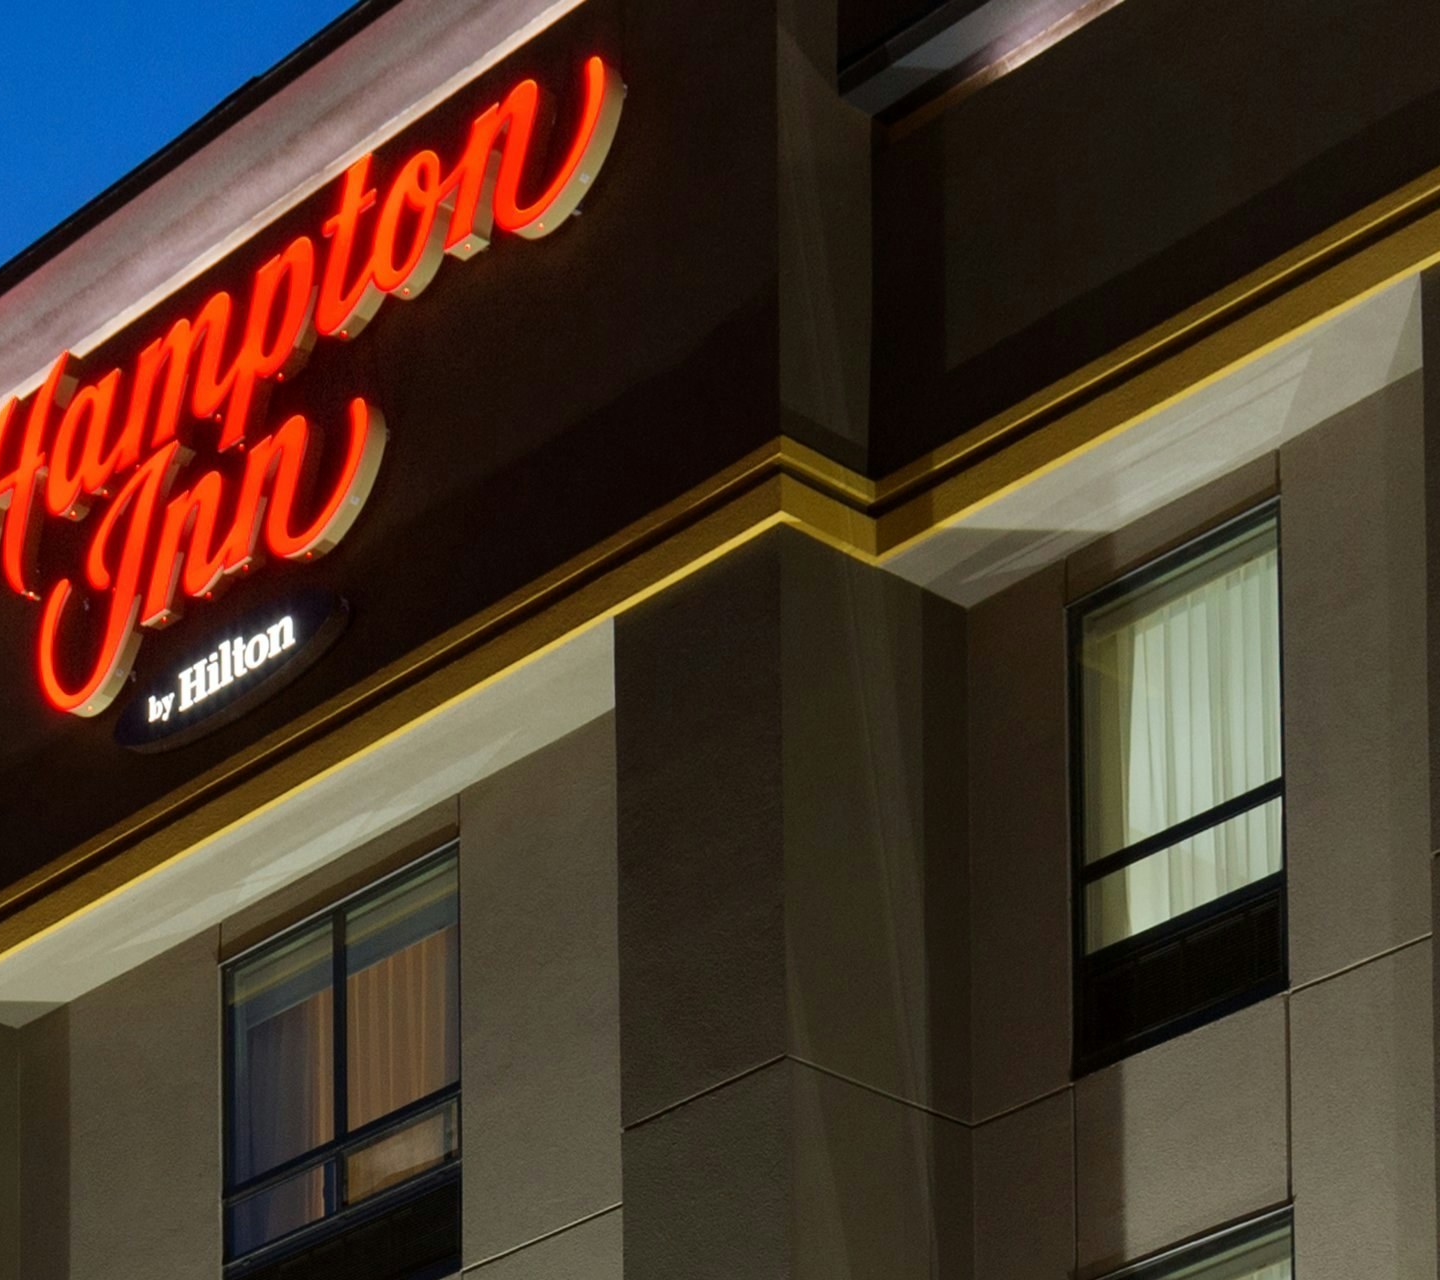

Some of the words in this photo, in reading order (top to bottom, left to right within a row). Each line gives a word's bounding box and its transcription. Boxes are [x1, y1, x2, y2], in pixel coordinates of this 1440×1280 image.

[39, 397, 376, 714] Inn
[148, 692, 175, 723] by
[178, 615, 296, 712] Hilton
